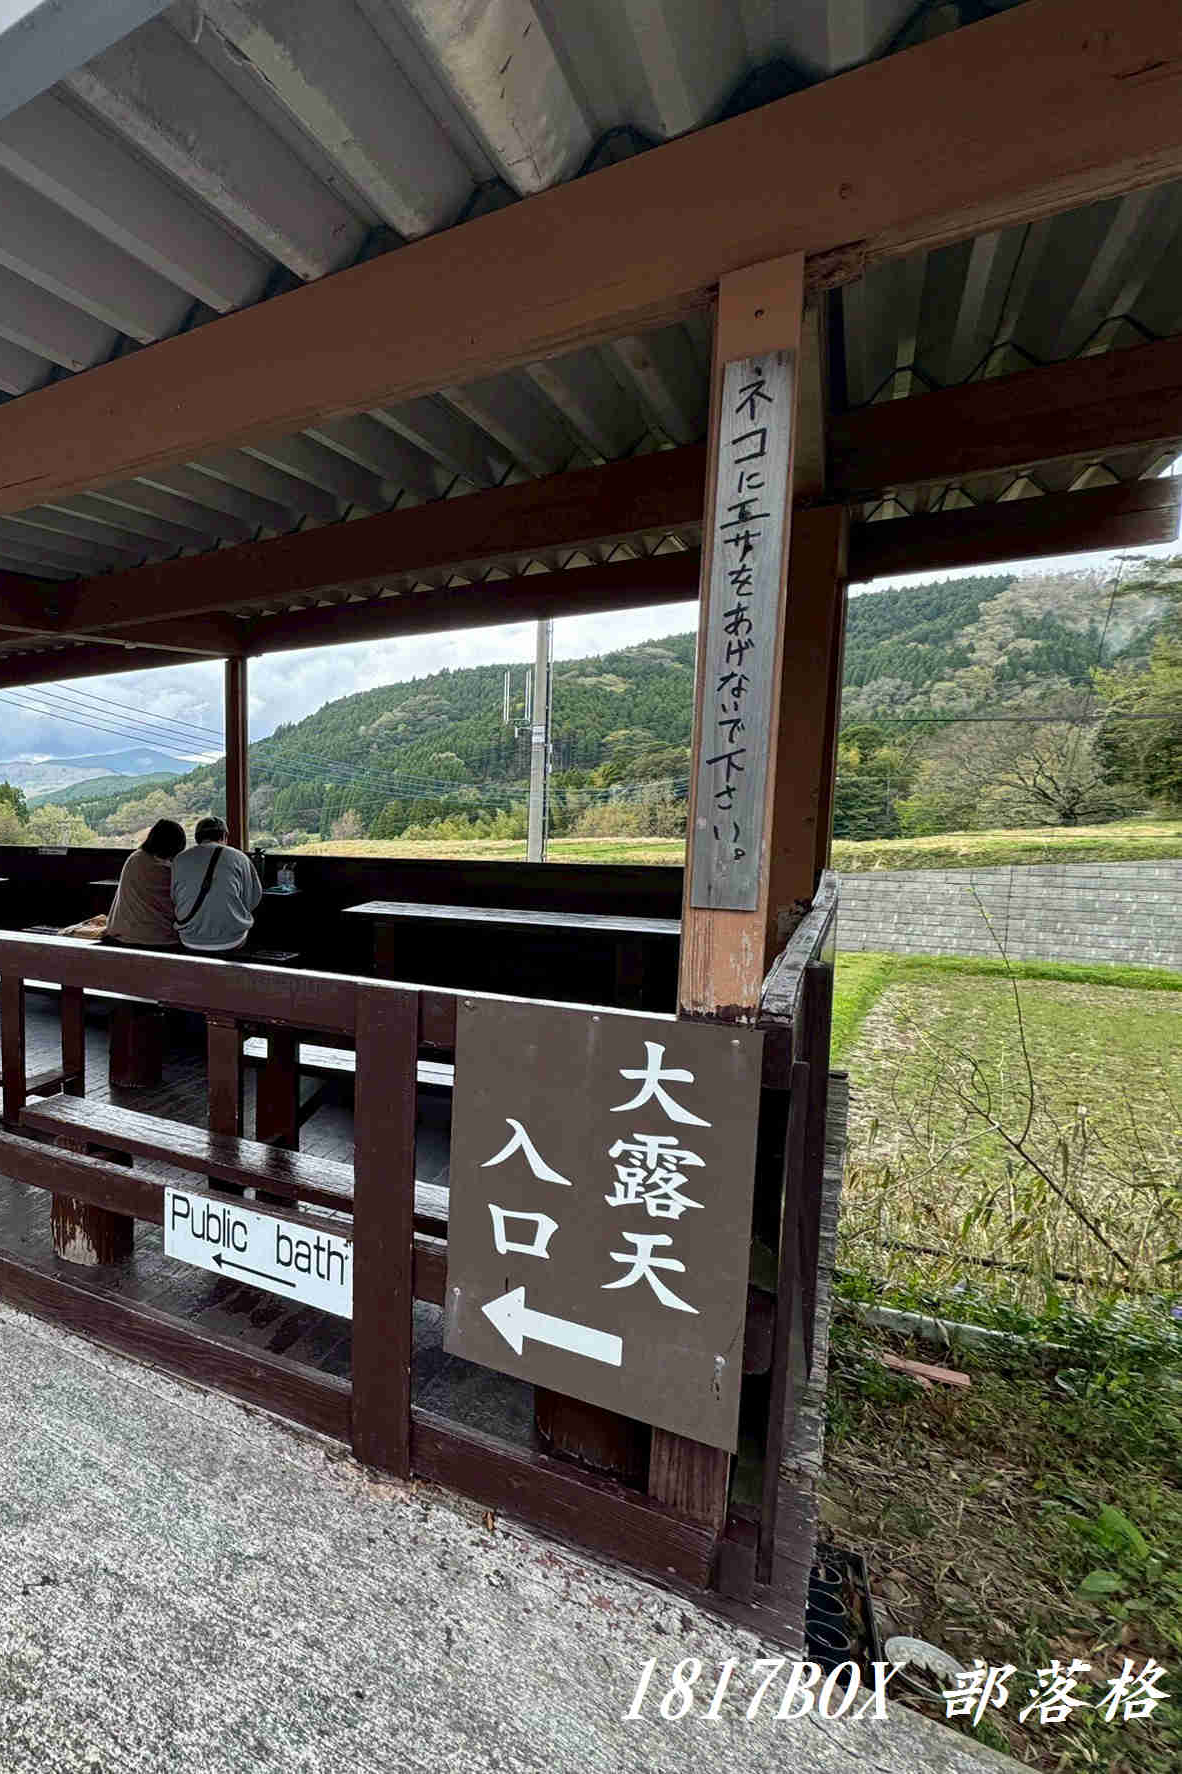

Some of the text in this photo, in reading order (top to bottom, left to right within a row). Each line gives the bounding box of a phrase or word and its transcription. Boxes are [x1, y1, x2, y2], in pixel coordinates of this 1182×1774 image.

[171, 1193, 345, 1286] Public bath
[480, 1117, 573, 1260] 入口
[601, 1040, 713, 1315] 大露天
